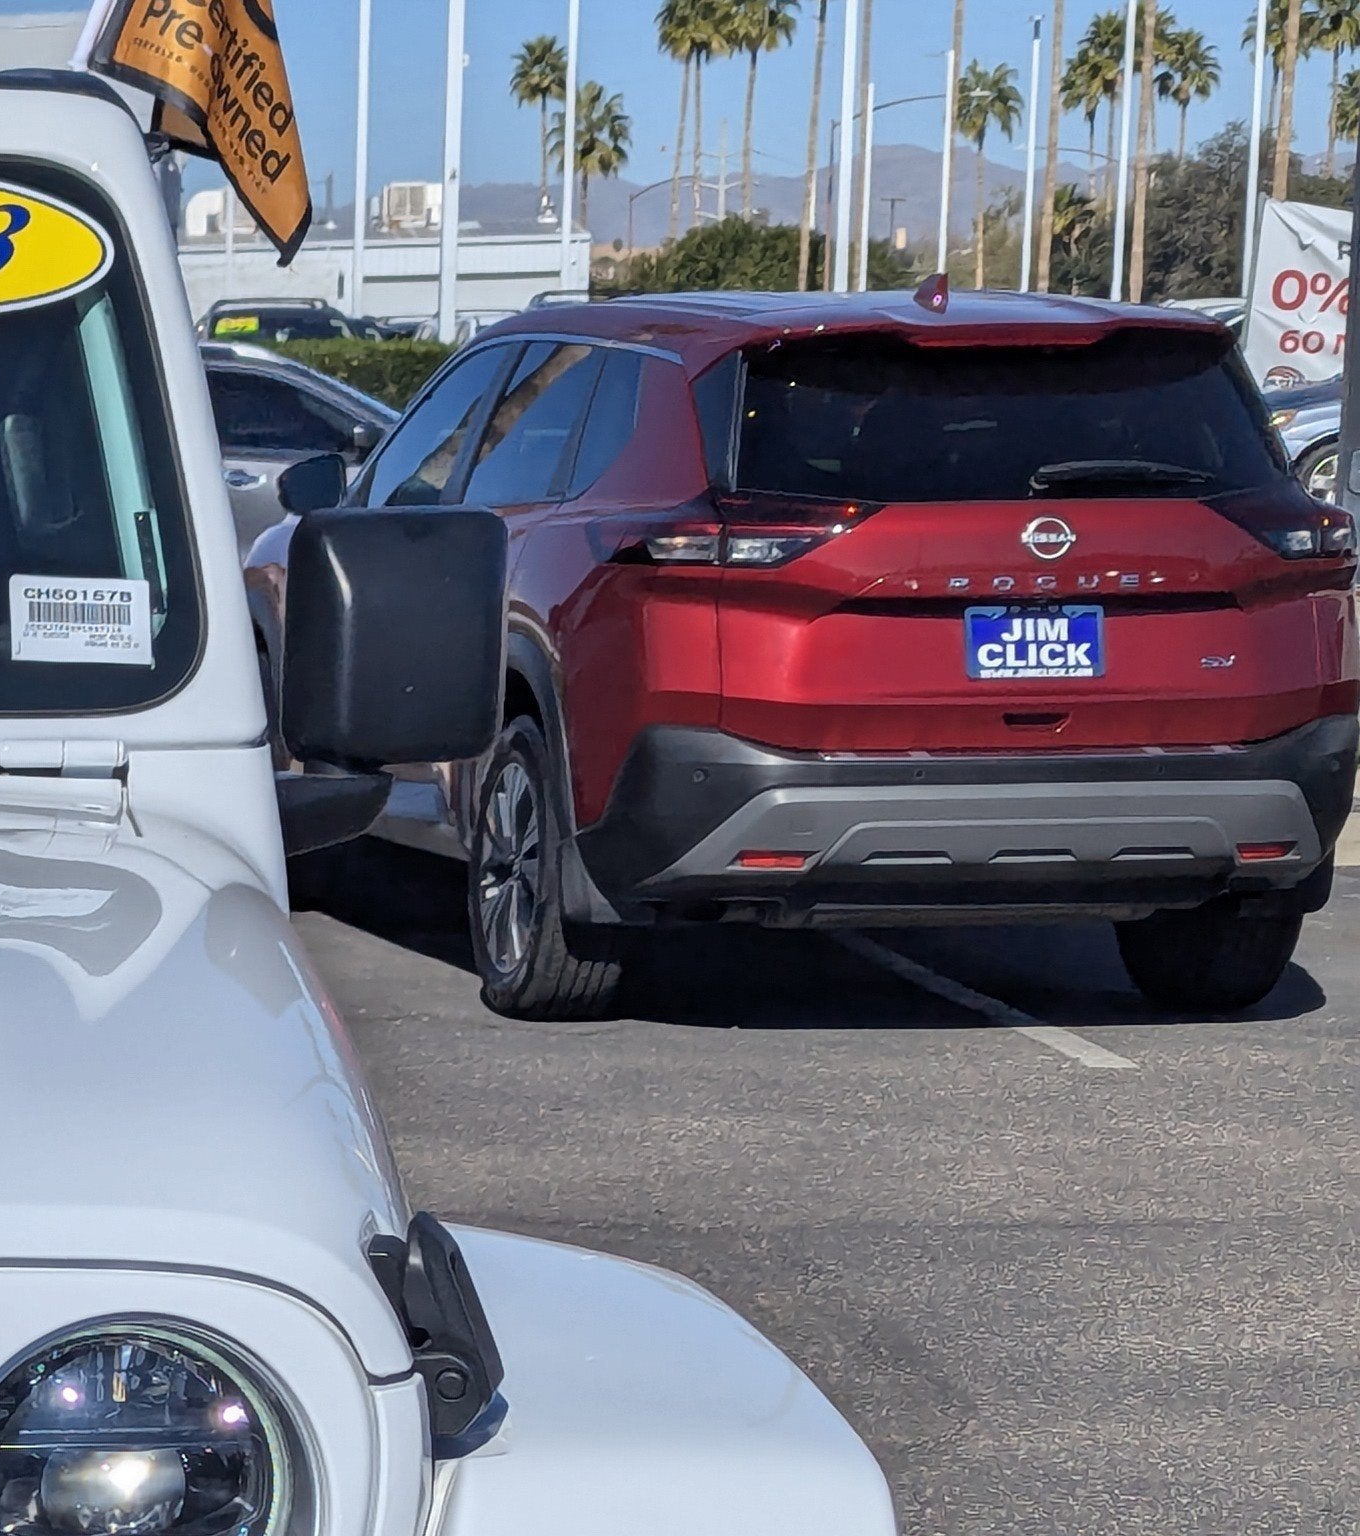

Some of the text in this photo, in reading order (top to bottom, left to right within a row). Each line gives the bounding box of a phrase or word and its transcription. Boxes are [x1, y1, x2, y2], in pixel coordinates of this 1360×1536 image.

[1279, 329, 1325, 354] 60
[948, 573, 1140, 592] ROGUE
[1001, 618, 1068, 642] JIM
[977, 643, 1092, 668] CLICK
